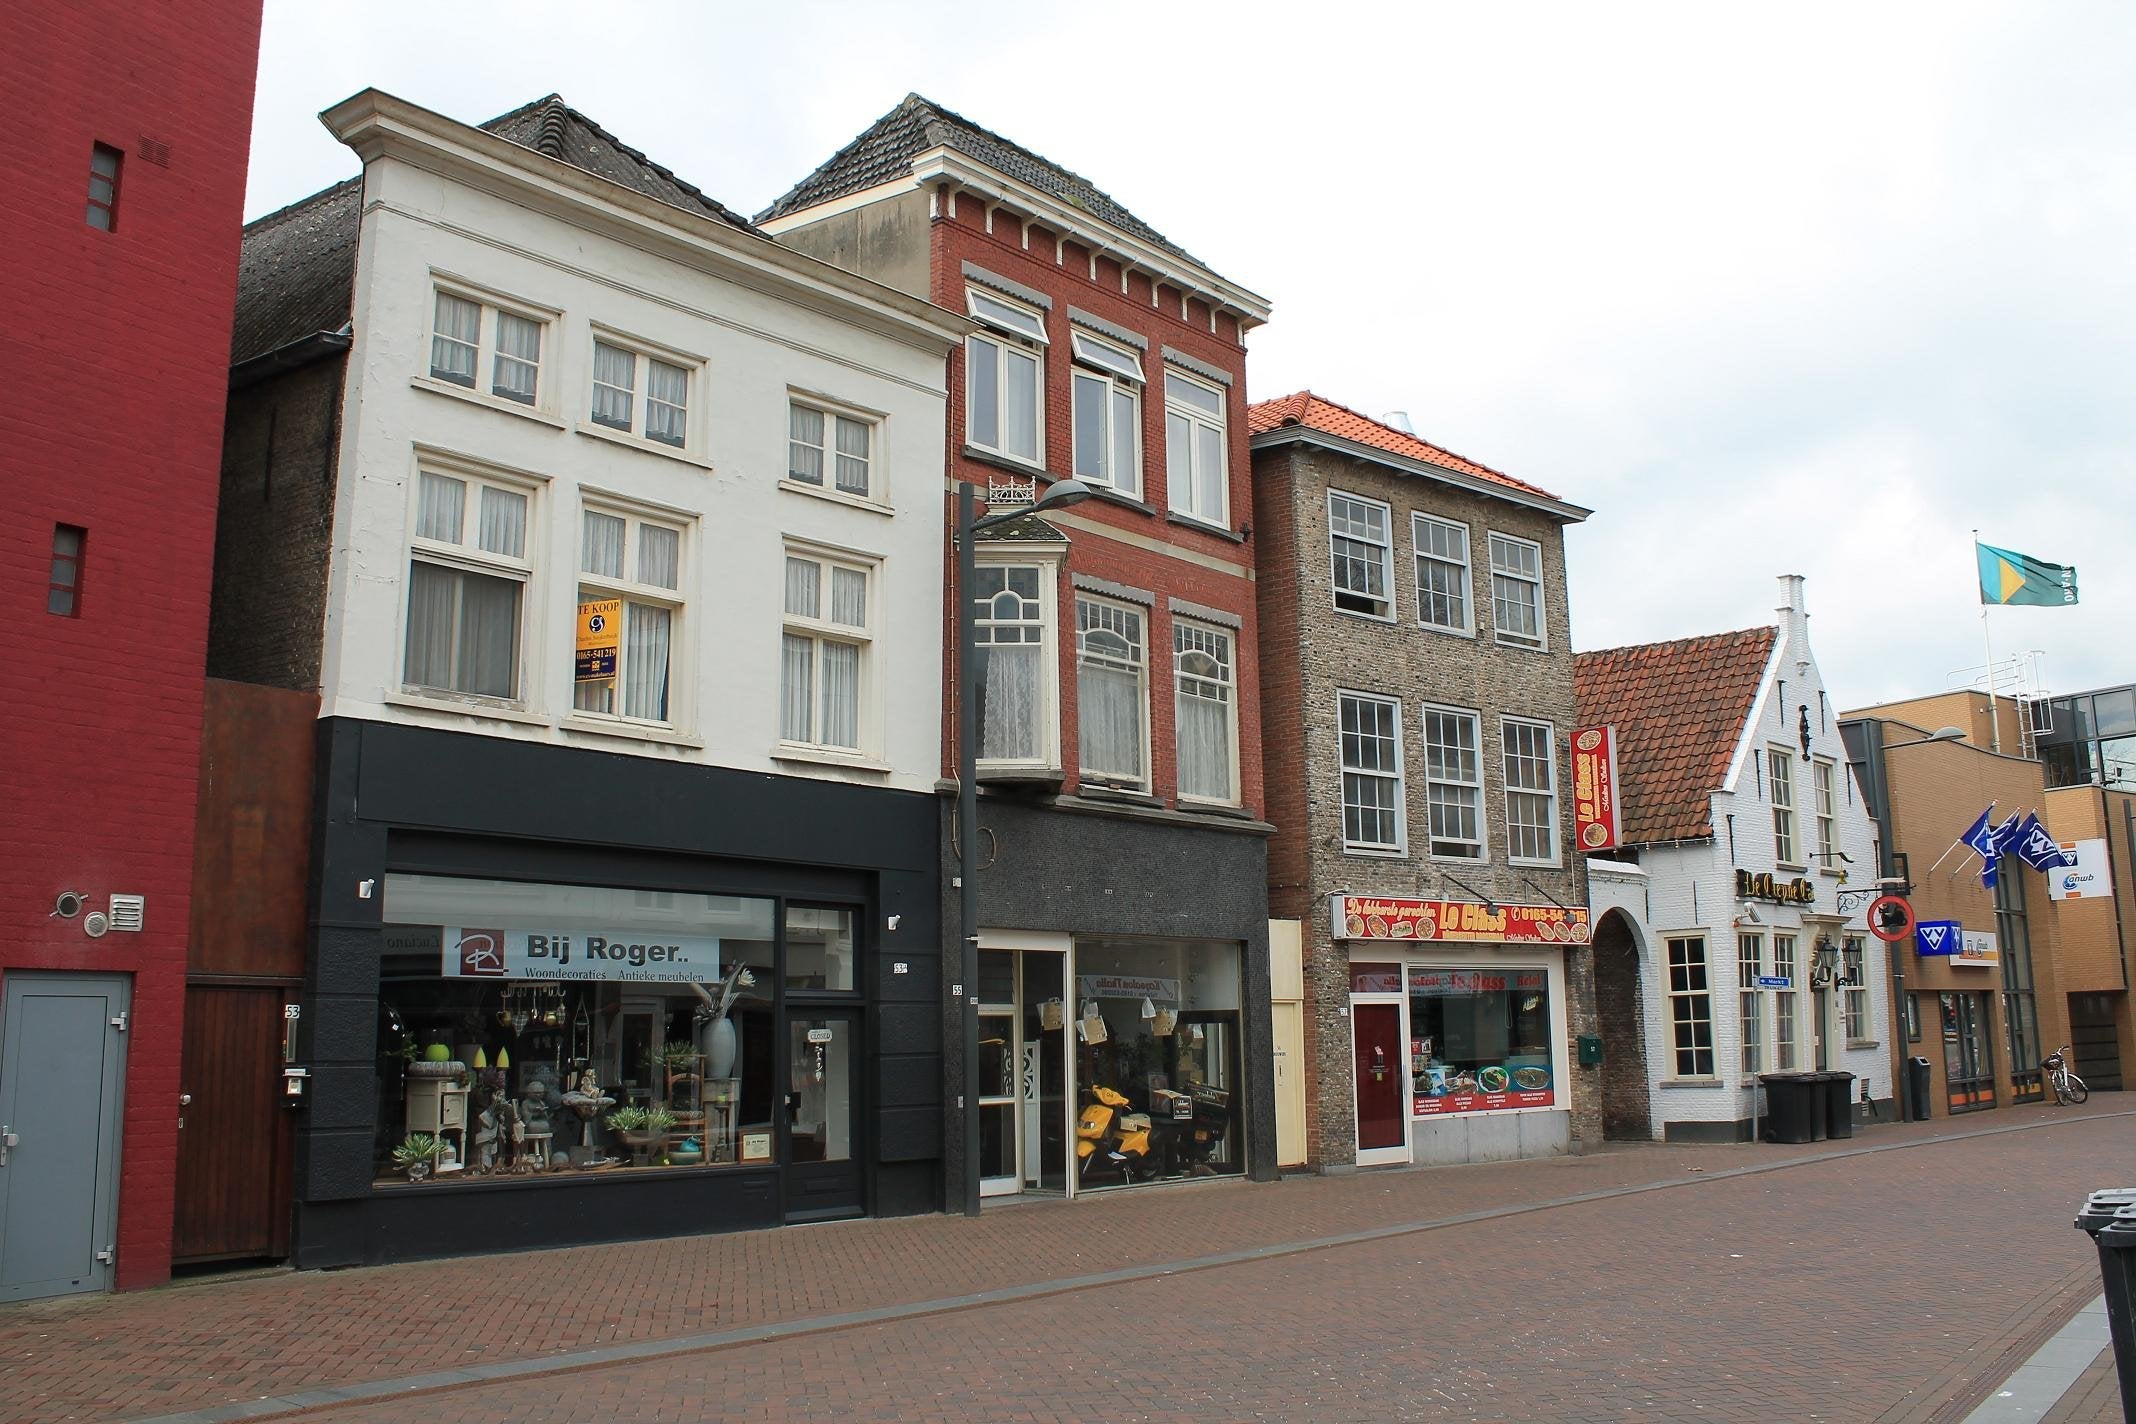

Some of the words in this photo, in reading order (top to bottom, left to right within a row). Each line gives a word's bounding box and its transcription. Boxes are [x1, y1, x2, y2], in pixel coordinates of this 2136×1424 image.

[578, 605, 590, 615] TE
[592, 602, 619, 614] KOOP
[1576, 753, 1593, 800] Class
[2069, 873, 2095, 884] anwb
[1439, 903, 1459, 930] Le
[1461, 904, 1507, 931] Class
[1521, 910, 1586, 922] 0165-5415
[528, 935, 570, 965] Bij
[587, 937, 688, 967] Roger..
[526, 967, 606, 980] Woondecoraties
[618, 969, 655, 982] Antieke
[658, 971, 704, 983] meubelen
[286, 1006, 299, 1017] 53
